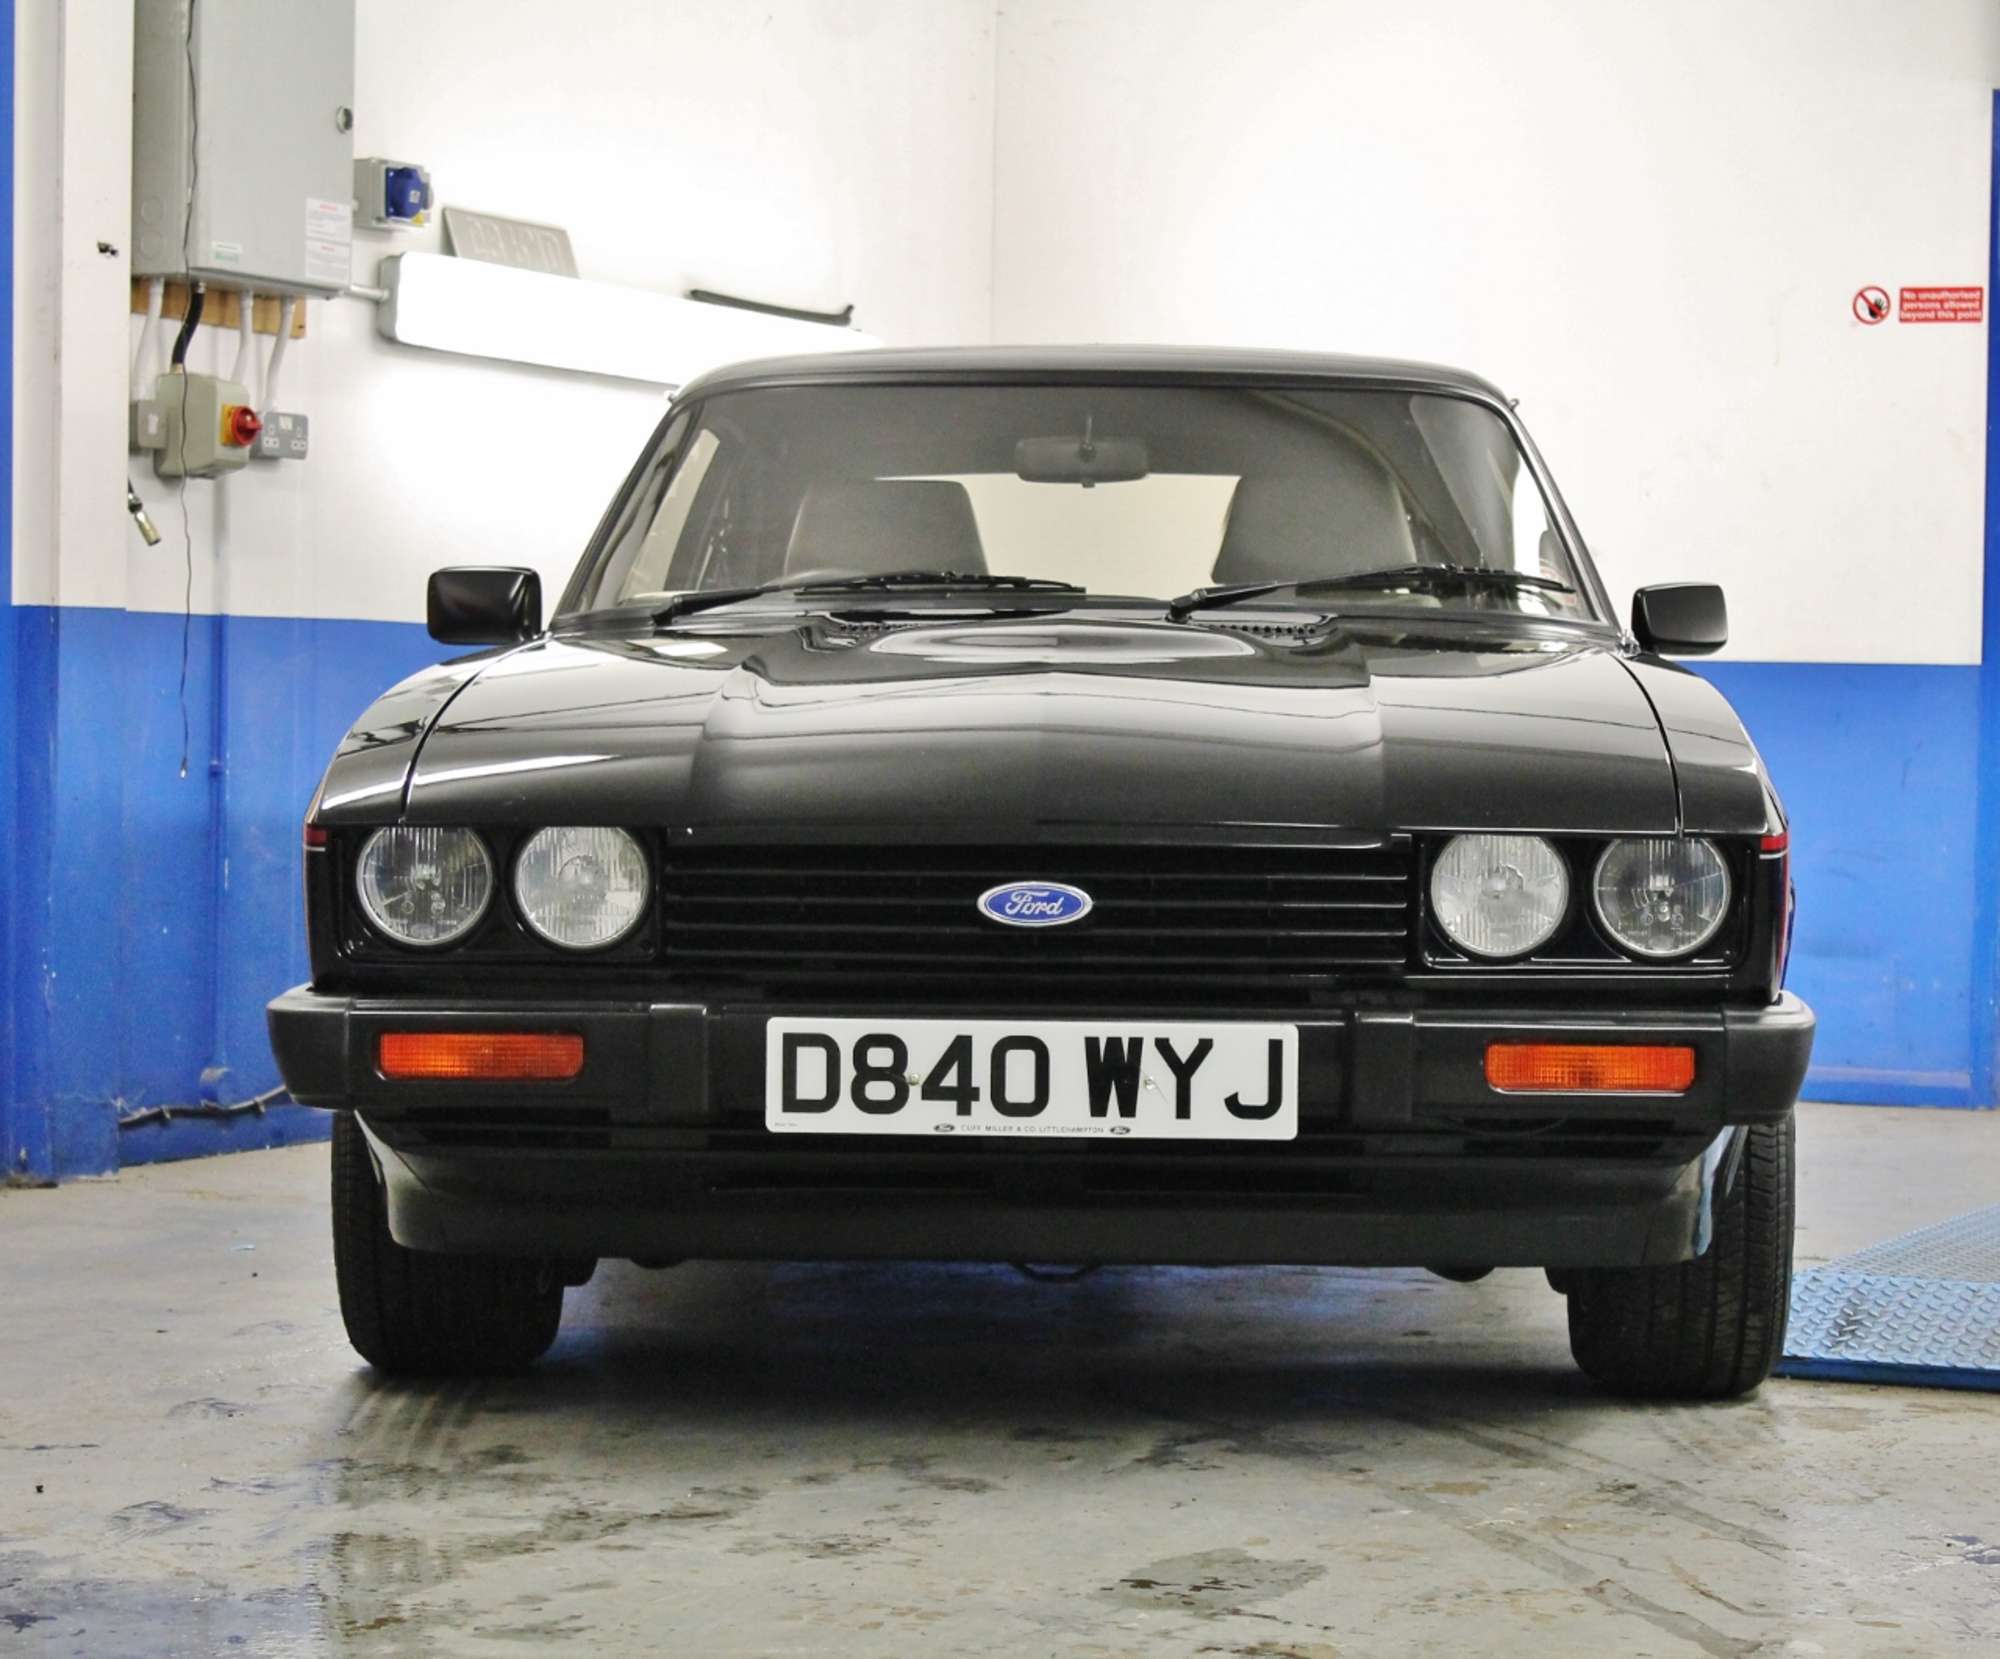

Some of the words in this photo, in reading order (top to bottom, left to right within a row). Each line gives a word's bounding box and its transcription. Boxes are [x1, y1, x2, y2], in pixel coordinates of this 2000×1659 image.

[1903, 291, 1916, 300] No
[1903, 302, 1941, 311] persons
[1943, 301, 1980, 310] allowed
[1901, 311, 1935, 321] beyond
[1937, 311, 1955, 320] this
[1957, 311, 1983, 321] point
[1005, 890, 1065, 915] Ford
[781, 1032, 1050, 1118] D840
[1084, 1036, 1284, 1120] WYJ
